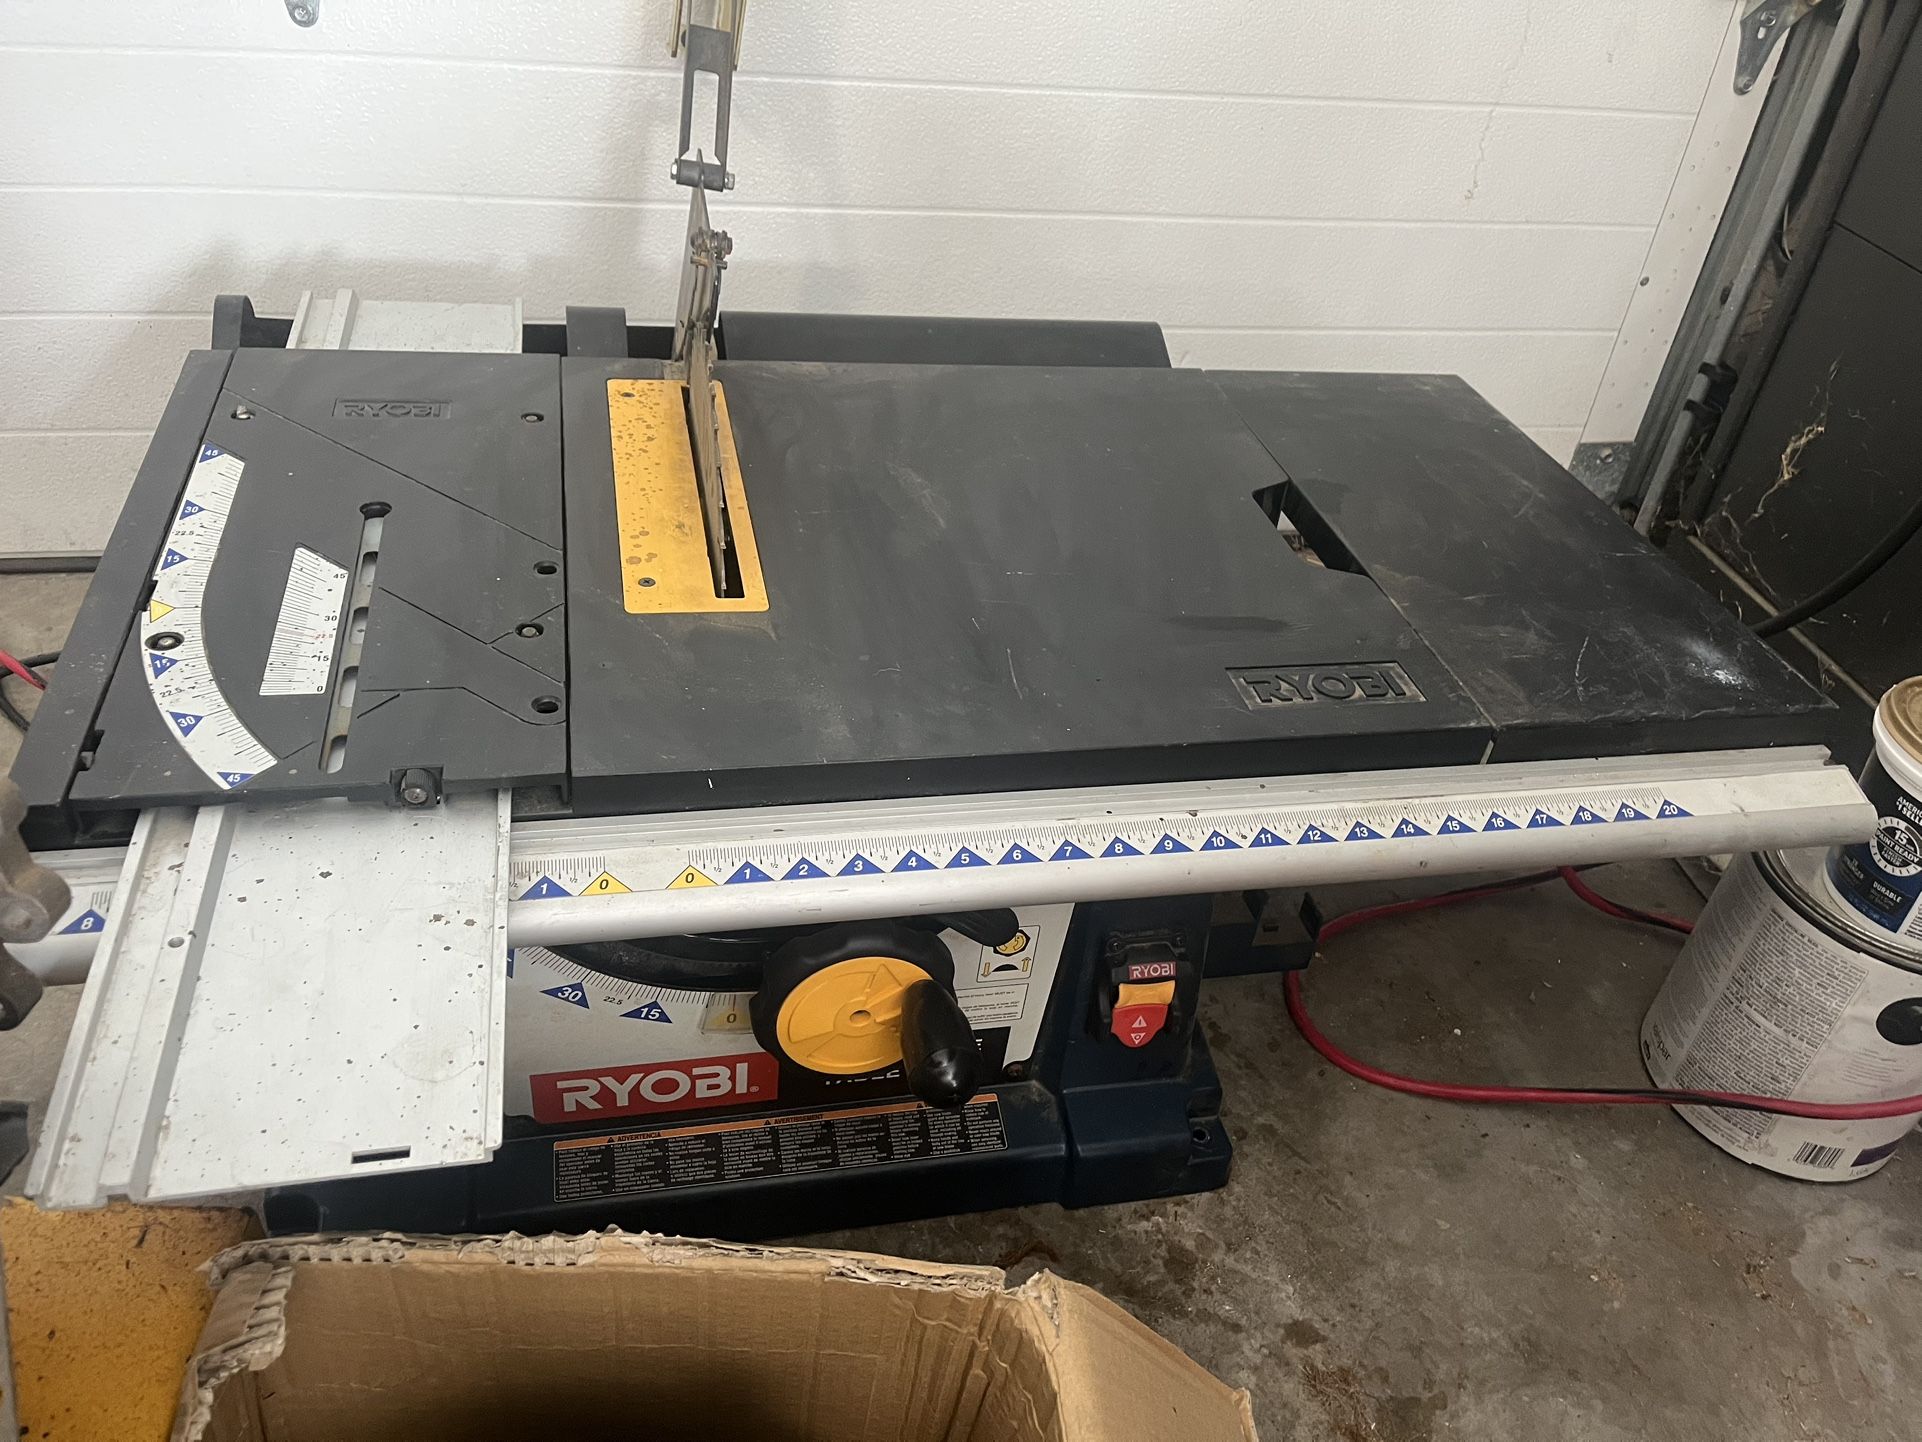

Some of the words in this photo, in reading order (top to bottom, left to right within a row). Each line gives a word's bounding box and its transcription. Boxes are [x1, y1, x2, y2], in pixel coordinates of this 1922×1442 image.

[344, 403, 440, 417] RYOBI
[166, 555, 180, 563] 15
[154, 659, 171, 668] 15
[1243, 671, 1406, 703] RYOBI
[178, 717, 195, 727] 30
[685, 873, 694, 884] 0
[743, 868, 750, 879] 1
[799, 864, 808, 875] 2
[854, 860, 863, 871] 3
[908, 857, 917, 867] 4
[961, 853, 970, 864] 5
[1012, 850, 1022, 860] 6
[1064, 846, 1072, 856] 7
[1114, 843, 1123, 853] 8
[1164, 840, 1173, 850] 9
[1211, 836, 1225, 847] 10
[1259, 833, 1272, 844] 11
[1308, 830, 1321, 841] 12
[1354, 827, 1369, 837] 13
[1401, 824, 1415, 834] 14
[1447, 820, 1460, 831] 15
[1491, 818, 1504, 828] 16
[1535, 814, 1547, 824] 17
[1579, 811, 1592, 821] 18
[1621, 808, 1634, 818] 19
[1663, 804, 1678, 815] 20
[1895, 830, 1908, 845] 15
[1876, 830, 1895, 848] PAINT
[1894, 845, 1919, 863] READY
[541, 883, 548, 895] 1
[600, 879, 609, 890] 0
[1873, 881, 1902, 903] DURABLE
[81, 917, 94, 930] 8
[1131, 963, 1174, 978] RYOBI
[557, 986, 583, 1001] 30
[603, 995, 623, 1005] 22.5
[640, 1006, 662, 1020] 15
[727, 1013, 736, 1023] 0
[556, 1062, 748, 1112] RYOBI
[618, 1132, 661, 1141] ADVERTENCIA
